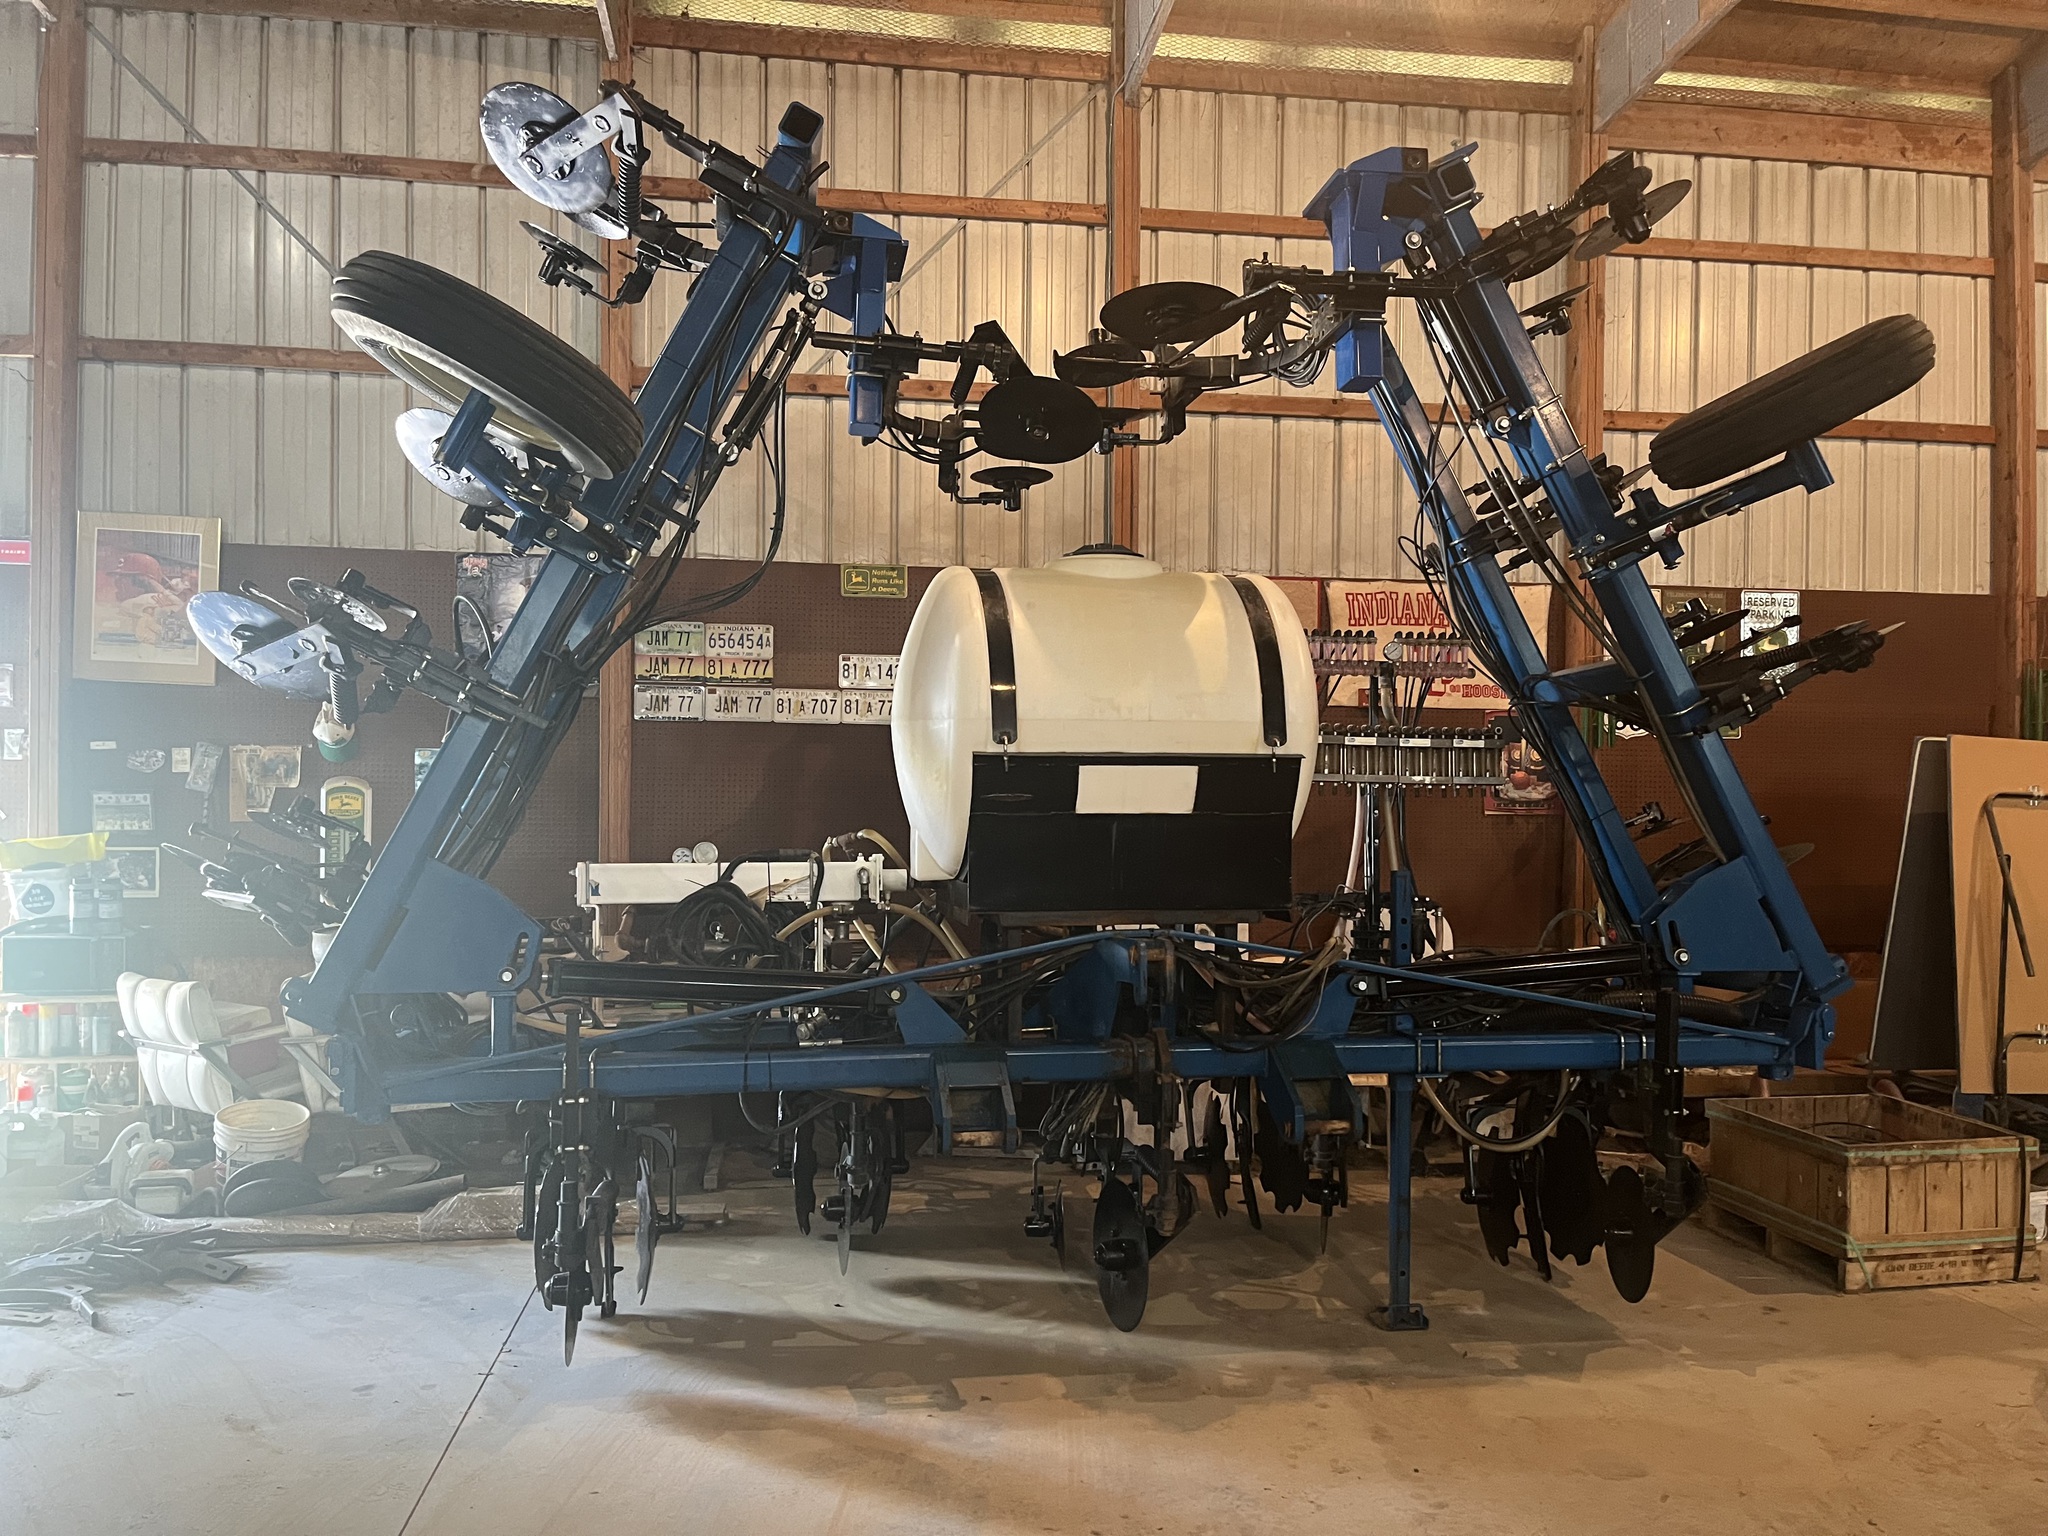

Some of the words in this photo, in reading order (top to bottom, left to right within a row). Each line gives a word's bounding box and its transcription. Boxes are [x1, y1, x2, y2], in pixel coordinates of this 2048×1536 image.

[871, 569, 898, 577] Nothing
[1345, 591, 1450, 627] INDIANA
[1747, 597, 1795, 607] RESERVED
[1750, 609, 1791, 620] PARKING
[677, 631, 691, 647] 77
[708, 632, 764, 650] 656454
[765, 635, 771, 648] A
[645, 657, 669, 674] JAM
[678, 658, 694, 674] 77
[708, 659, 723, 676] 81
[731, 662, 737, 674] A
[742, 660, 770, 676] 777
[842, 664, 857, 680] 81
[865, 666, 871, 678] A
[645, 694, 669, 713] JAM
[678, 695, 694, 713] 77
[714, 696, 738, 713] JAM
[746, 696, 762, 713] 77
[776, 698, 792, 714] 81
[799, 700, 806, 712] A
[811, 698, 838, 715] 707
[844, 698, 859, 715] 81
[866, 701, 873, 713] A
